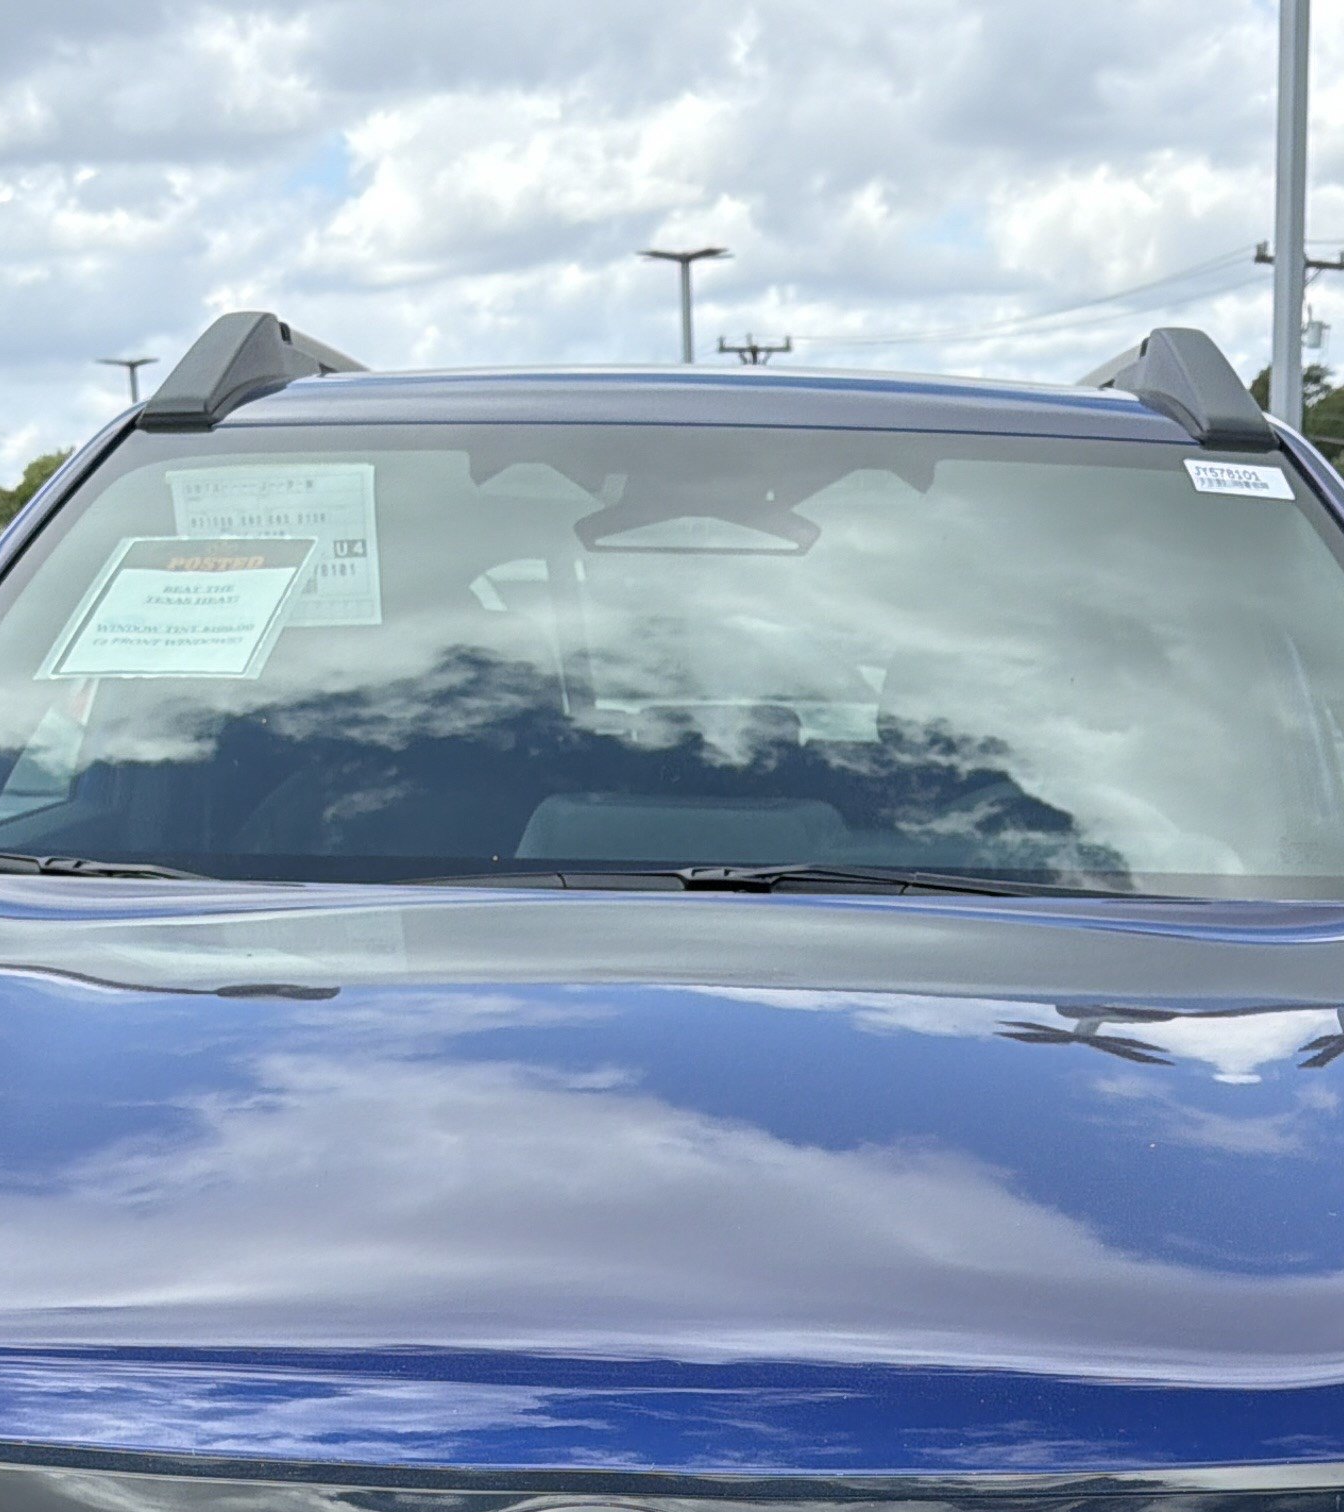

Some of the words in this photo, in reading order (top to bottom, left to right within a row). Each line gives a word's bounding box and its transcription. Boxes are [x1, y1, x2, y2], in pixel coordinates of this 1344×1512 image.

[97, 623, 158, 634] WINDOW
[165, 623, 198, 634] TINT
[111, 637, 162, 647] FRONT
